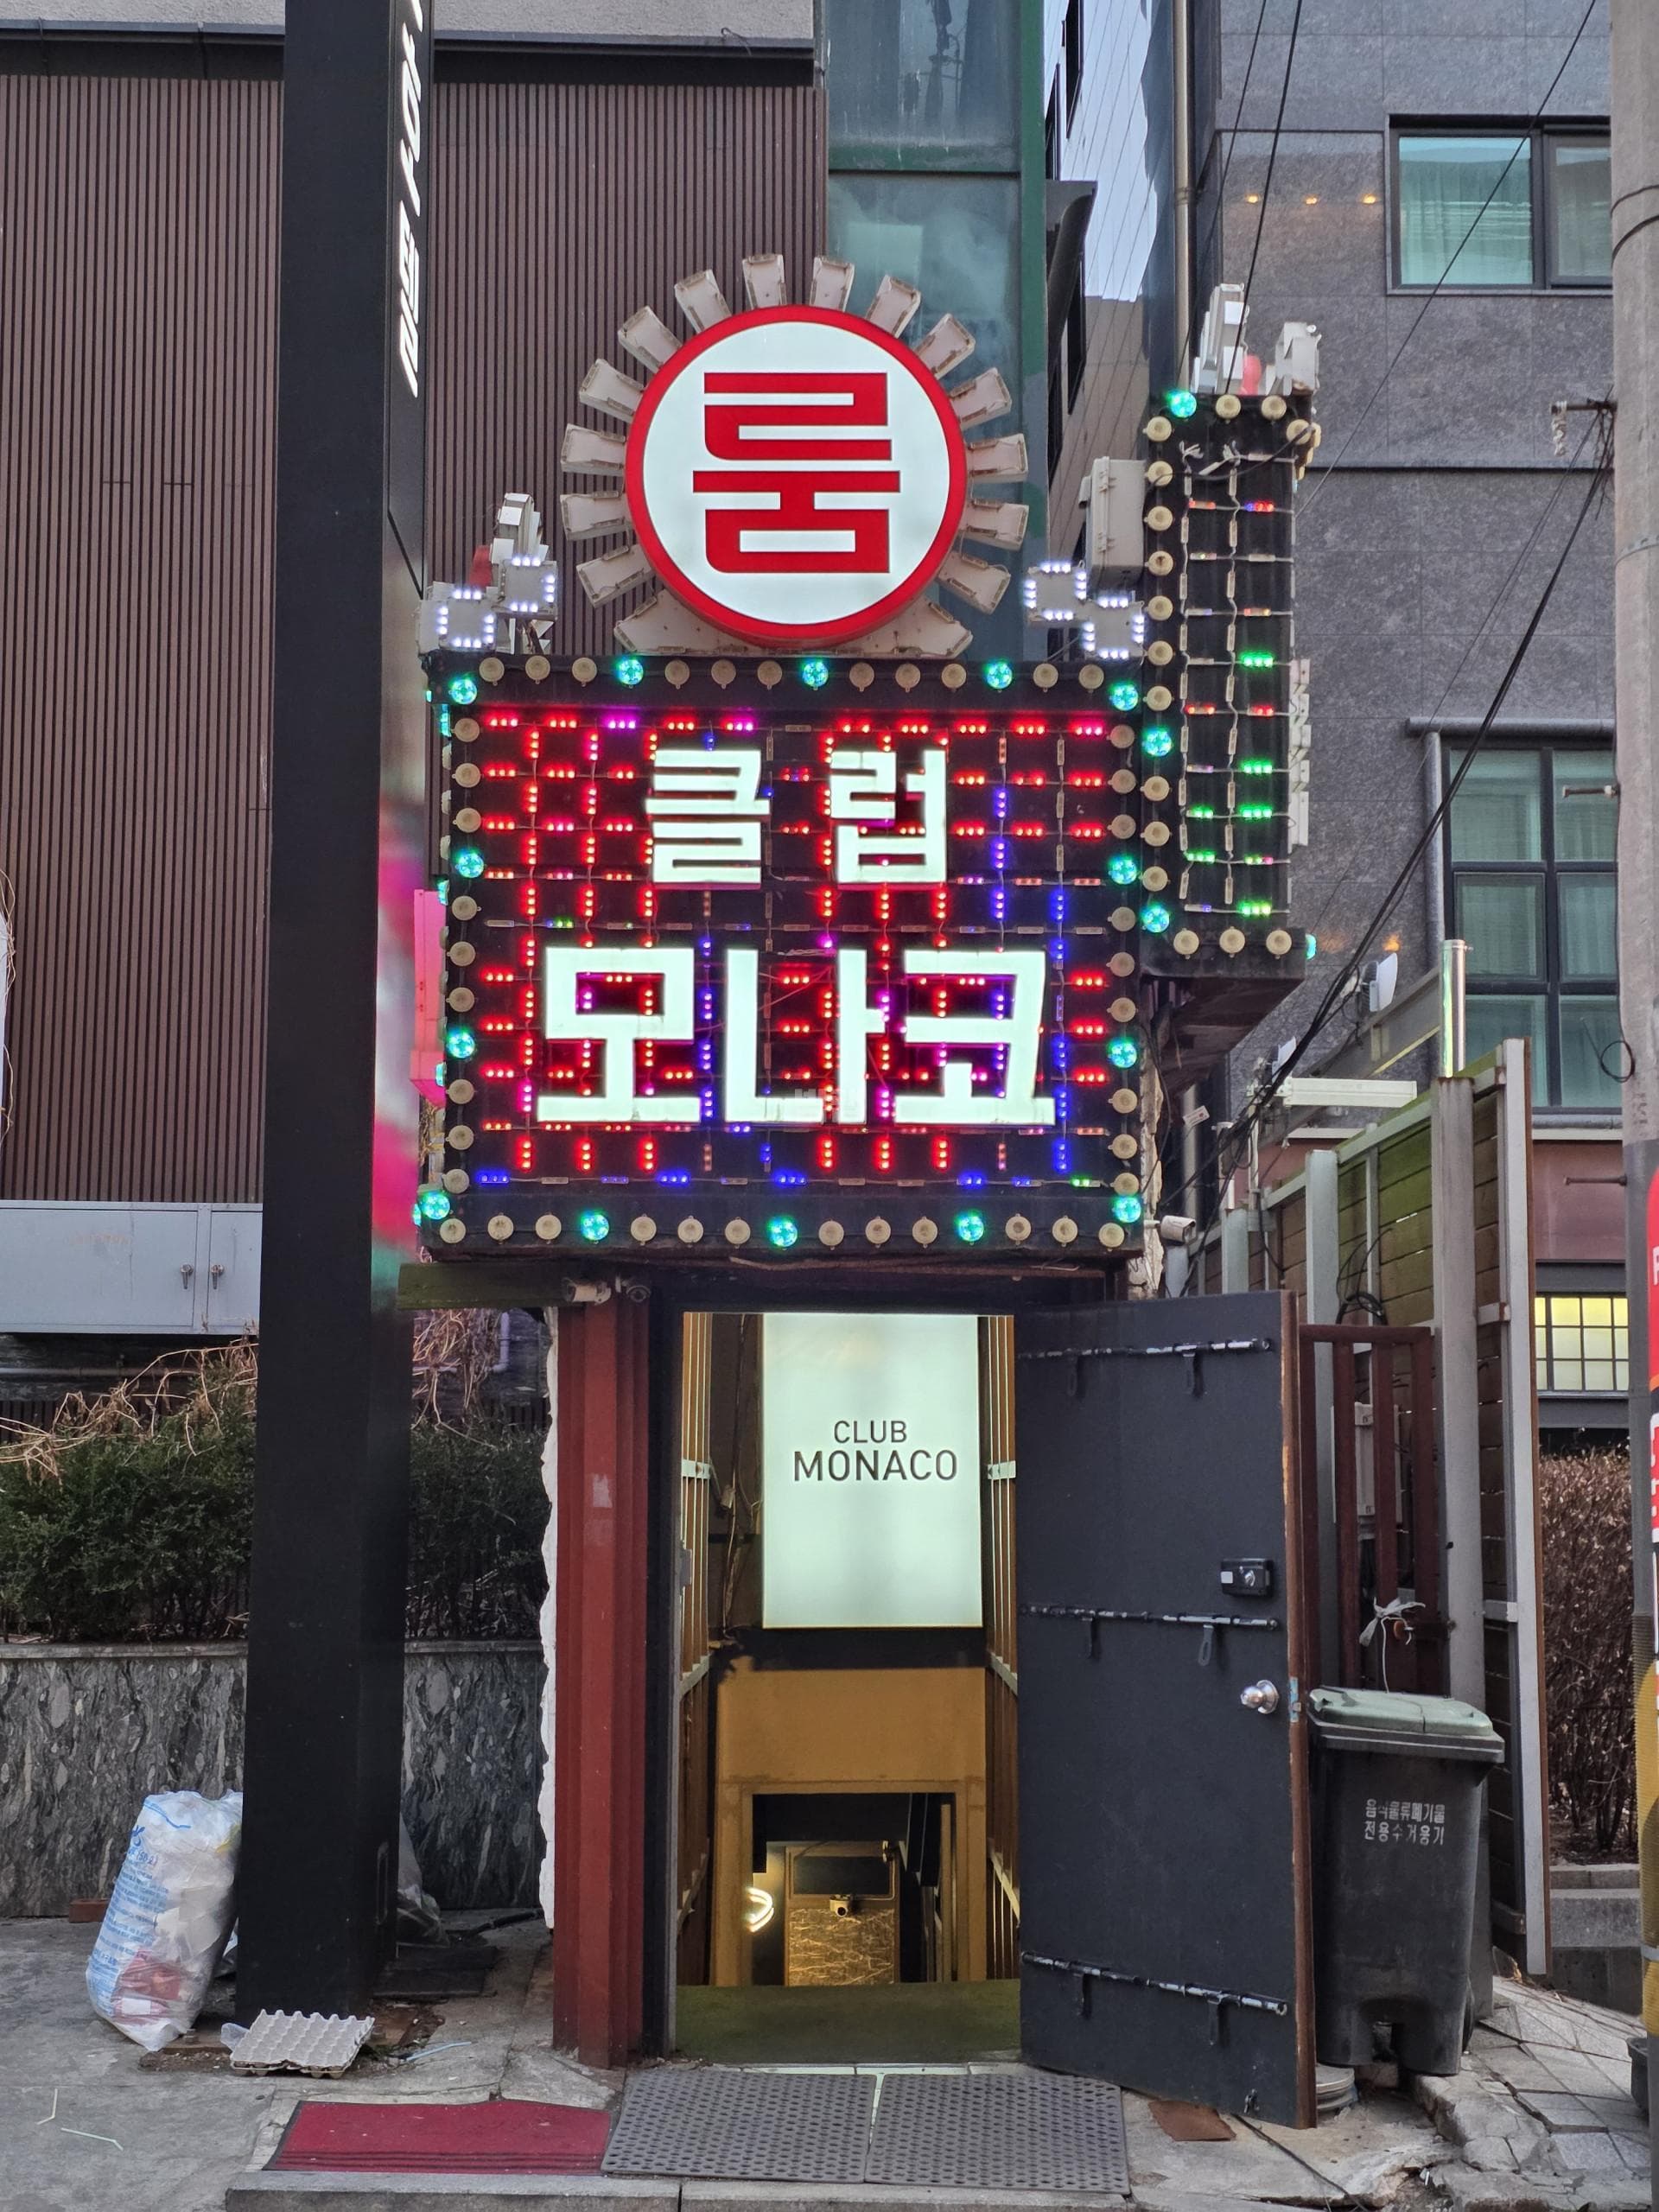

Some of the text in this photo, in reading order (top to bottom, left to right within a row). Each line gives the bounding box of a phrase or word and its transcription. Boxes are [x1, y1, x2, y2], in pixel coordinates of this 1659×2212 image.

[398, 0, 423, 398] 호텔
[692, 372, 900, 574] 룸
[645, 749, 946, 884] 클럽
[537, 947, 1056, 1124] 모나코
[793, 1449, 958, 1482] MONACO
[833, 1420, 908, 1445] CLUB
[1364, 1821, 1445, 1846] 전용수거용기
